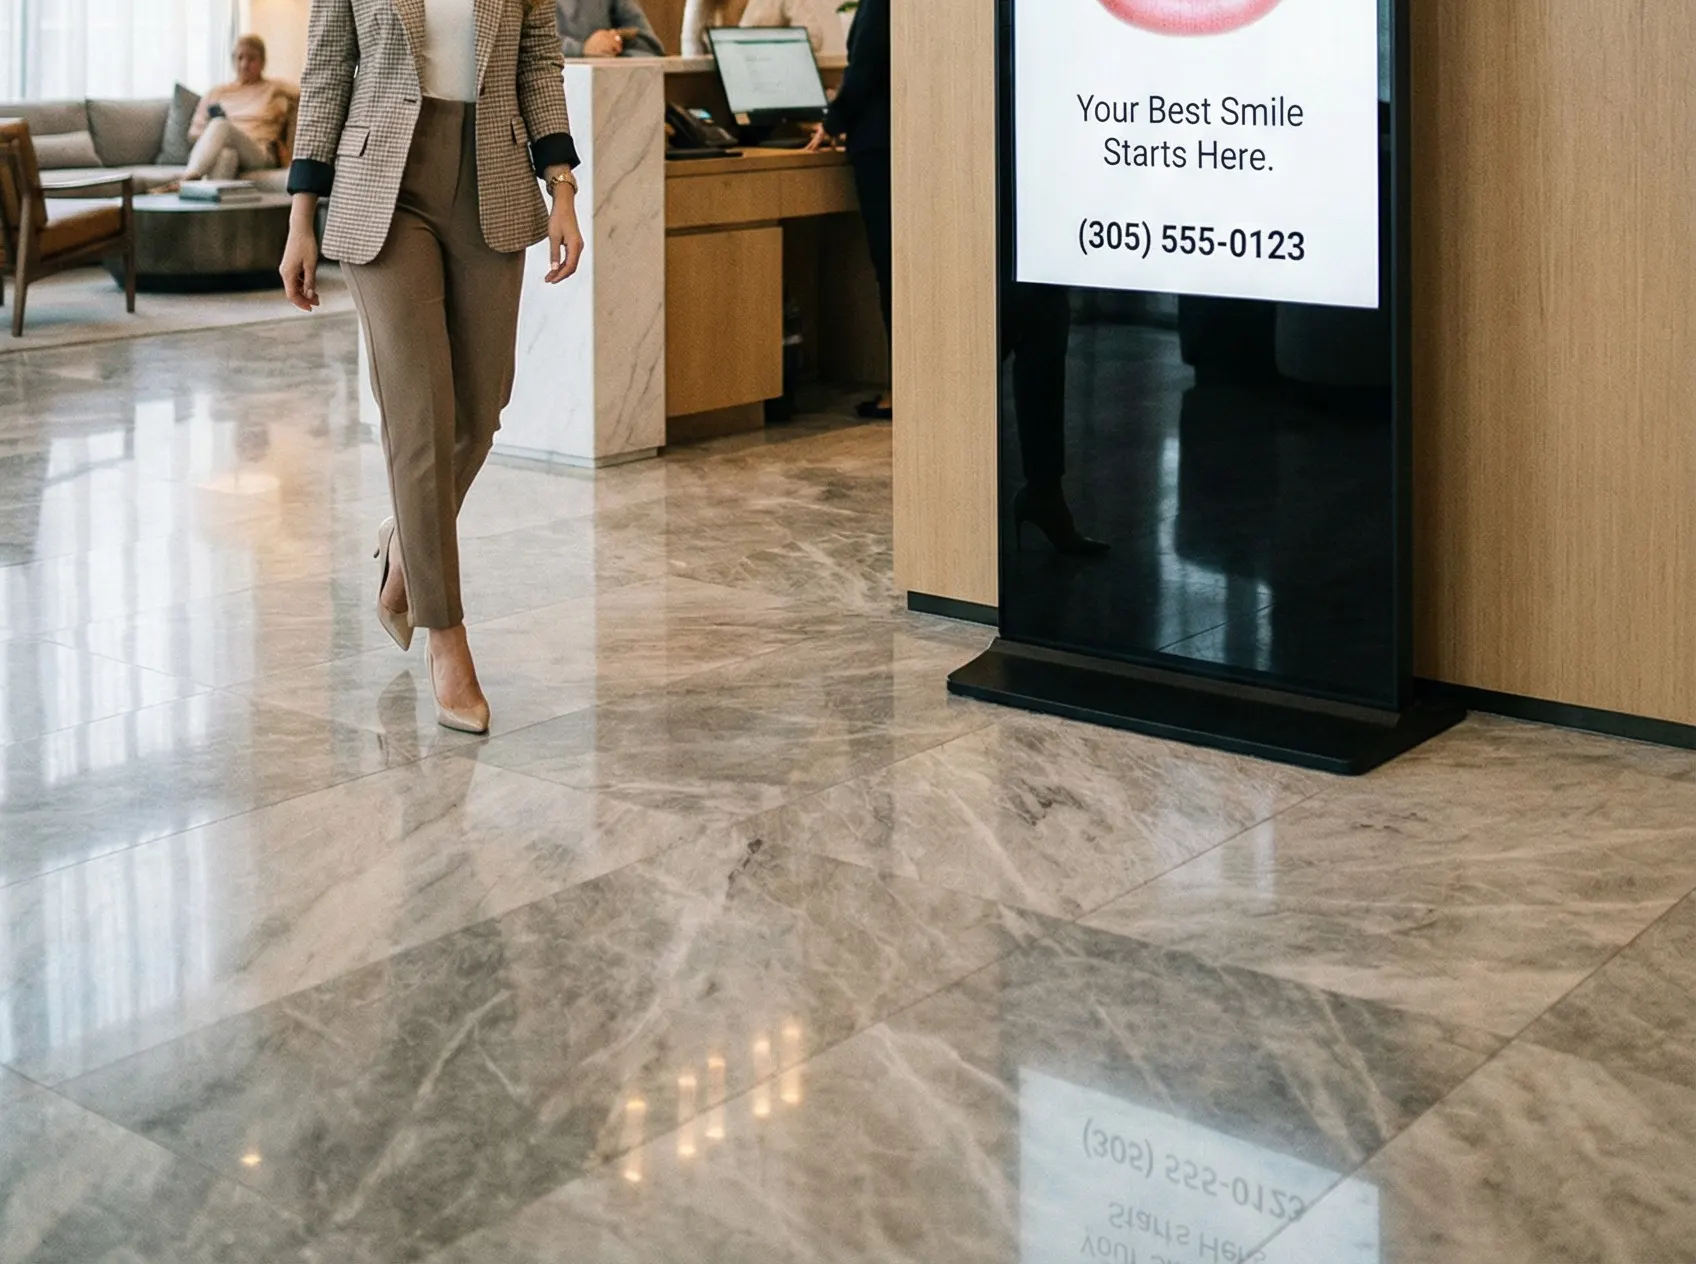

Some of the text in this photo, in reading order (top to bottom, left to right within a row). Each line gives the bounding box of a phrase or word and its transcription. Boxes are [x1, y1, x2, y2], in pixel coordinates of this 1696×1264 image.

[1077, 94, 1304, 127] Your Best Smile
[1103, 137, 1274, 172] Starts Here.
[1078, 217, 1305, 261] (305) 555-0123
